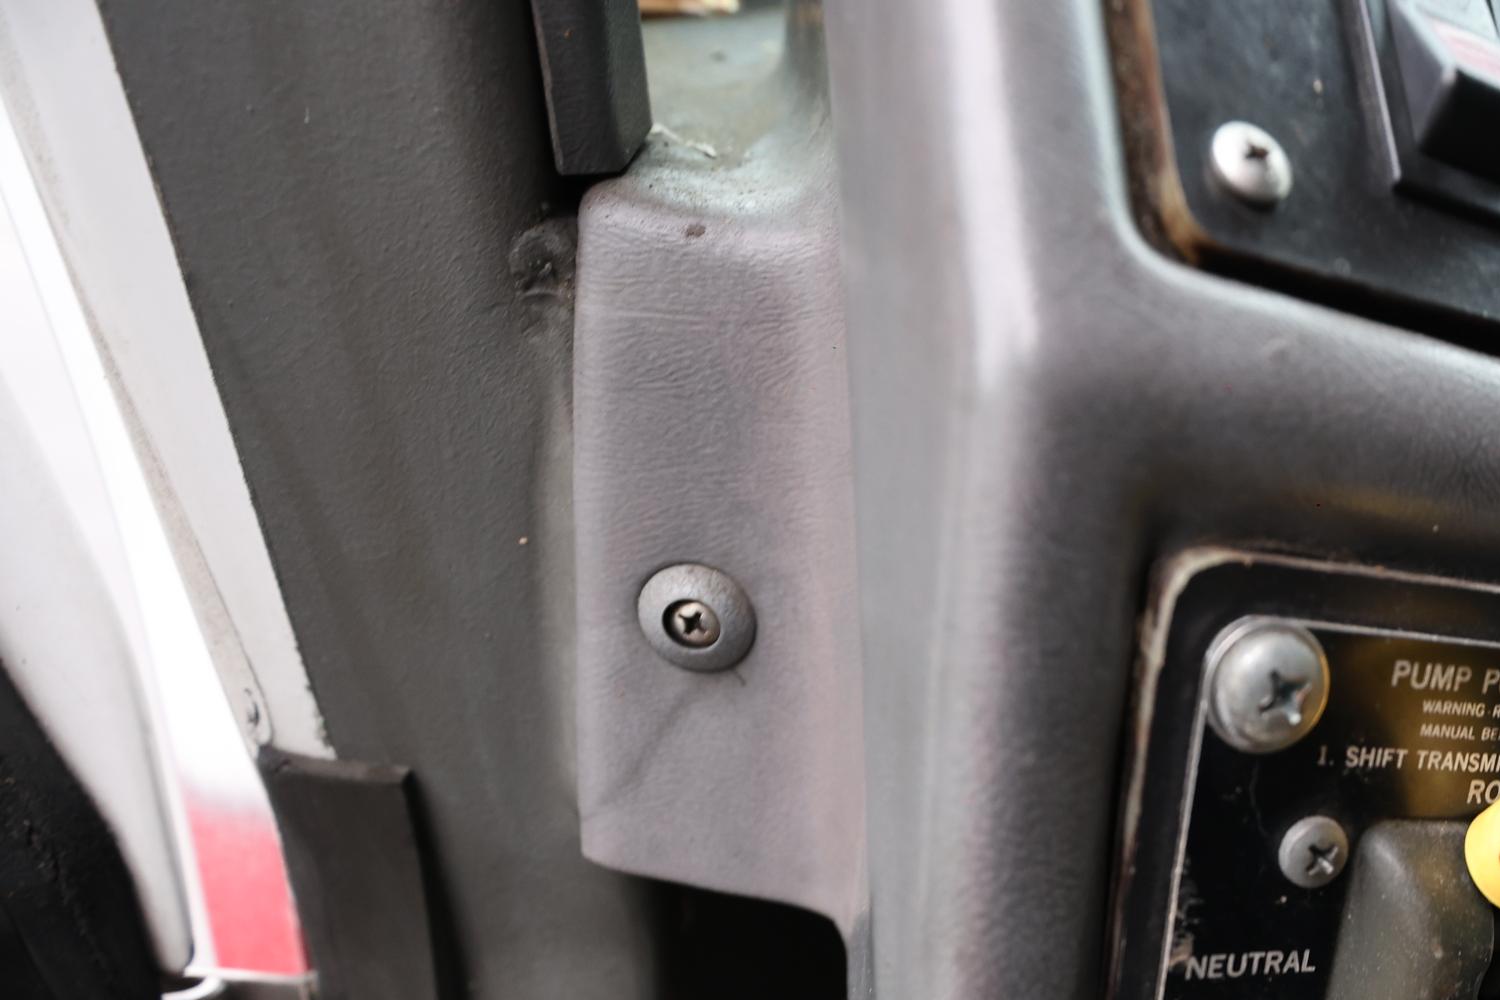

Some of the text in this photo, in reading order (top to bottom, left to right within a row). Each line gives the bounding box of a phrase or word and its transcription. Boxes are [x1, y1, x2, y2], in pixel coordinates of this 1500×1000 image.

[1391, 659, 1472, 692] PUMP
[1422, 699, 1485, 719] WARNING
[1420, 723, 1476, 741] MANUAL
[1345, 747, 1409, 770] SHIFT
[1184, 948, 1317, 981] NEUTRAL
